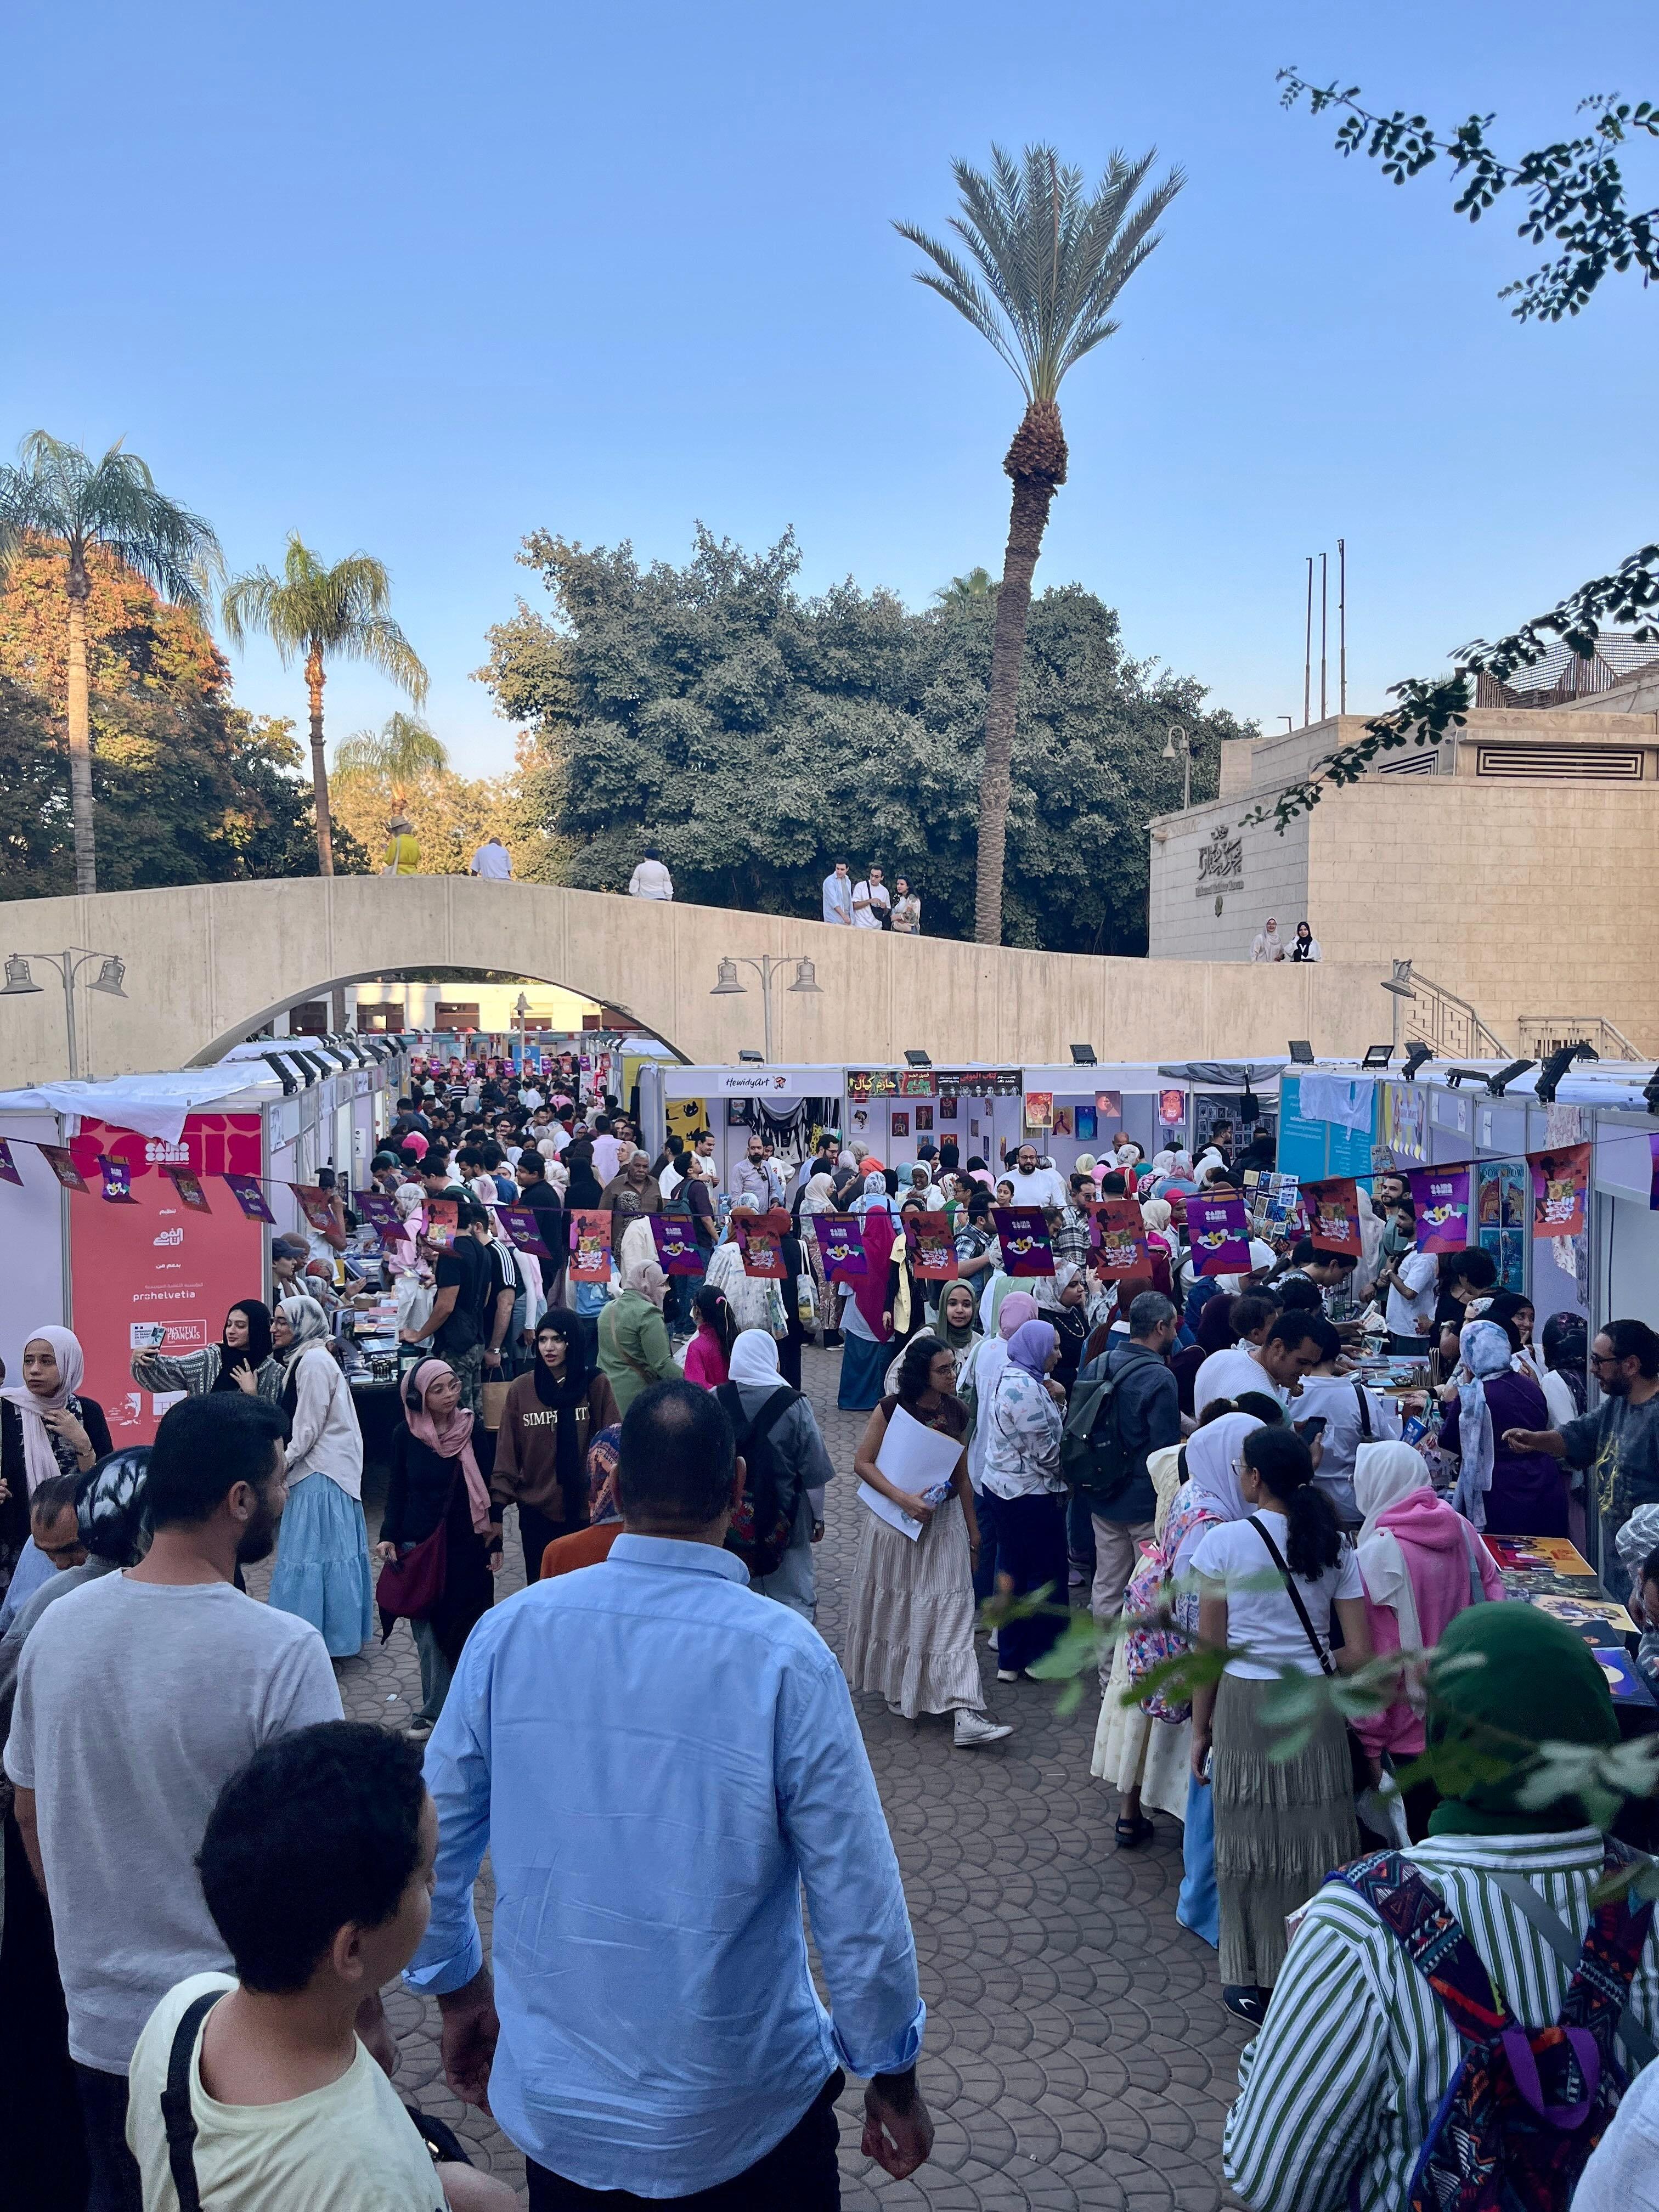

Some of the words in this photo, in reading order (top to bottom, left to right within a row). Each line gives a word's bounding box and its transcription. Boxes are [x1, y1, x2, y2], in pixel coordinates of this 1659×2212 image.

[726, 1077, 770, 1088] HewidyArt
[145, 1152, 190, 1162] COMIX
[133, 1290, 196, 1302] prohelvetia
[167, 1331, 201, 1341] FRANÇAIS
